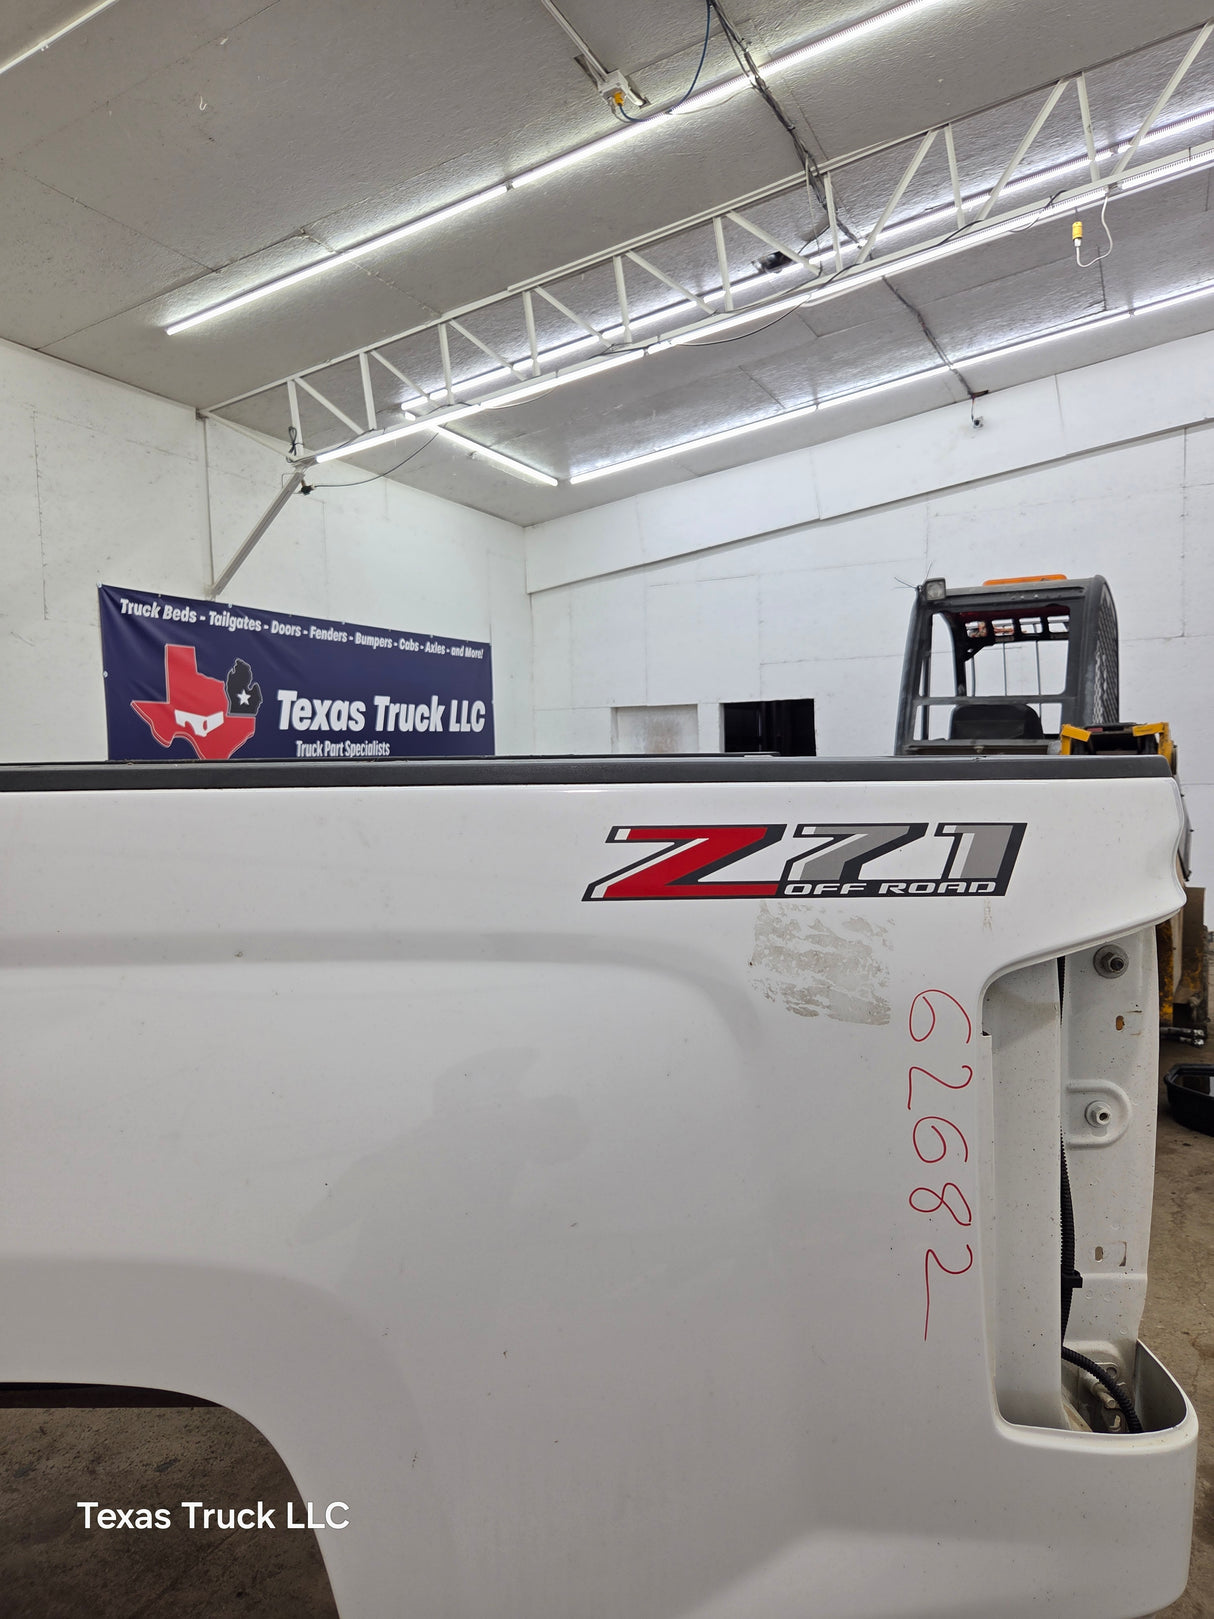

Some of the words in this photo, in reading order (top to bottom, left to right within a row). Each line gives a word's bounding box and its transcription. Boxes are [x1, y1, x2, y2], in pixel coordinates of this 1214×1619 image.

[120, 598, 161, 619] Truck
[162, 604, 197, 623] Beds
[209, 611, 262, 631] Tailgates
[271, 620, 302, 637] Doors
[310, 626, 348, 642] Fenders
[355, 632, 393, 649] Bumpers
[400, 639, 419, 652] Cabs
[425, 641, 446, 655] Axles
[451, 646, 464, 657] and
[465, 647, 484, 659] More!
[277, 689, 366, 732] Texas
[374, 695, 446, 732] Truck
[449, 699, 486, 732] LLC
[296, 740, 324, 757] Truck
[324, 740, 344, 756] Part
[344, 740, 391, 758] Specialists
[581, 823, 1028, 901] Z71
[783, 882, 866, 895] OFF
[878, 880, 998, 895] ROAD
[907, 989, 973, 1342] 62682
